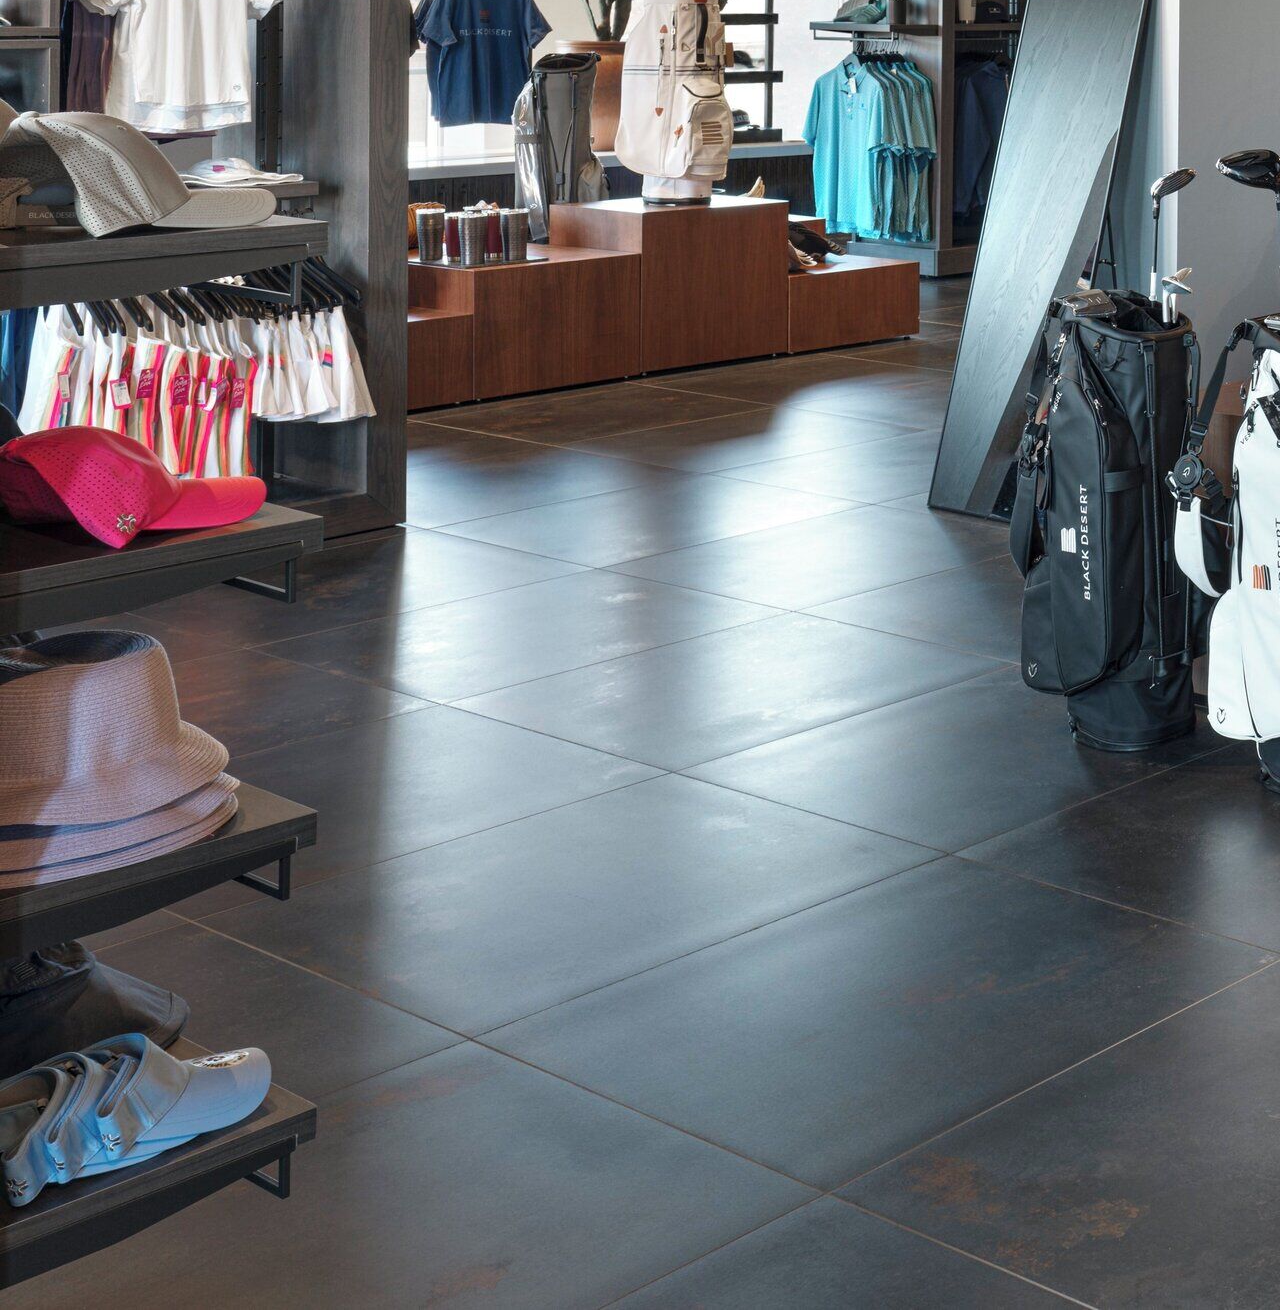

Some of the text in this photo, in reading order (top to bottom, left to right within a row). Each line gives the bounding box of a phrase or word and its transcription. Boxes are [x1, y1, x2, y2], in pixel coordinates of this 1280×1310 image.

[28, 211, 54, 219] BLACK
[1079, 484, 1091, 601] BLACK DESERT
